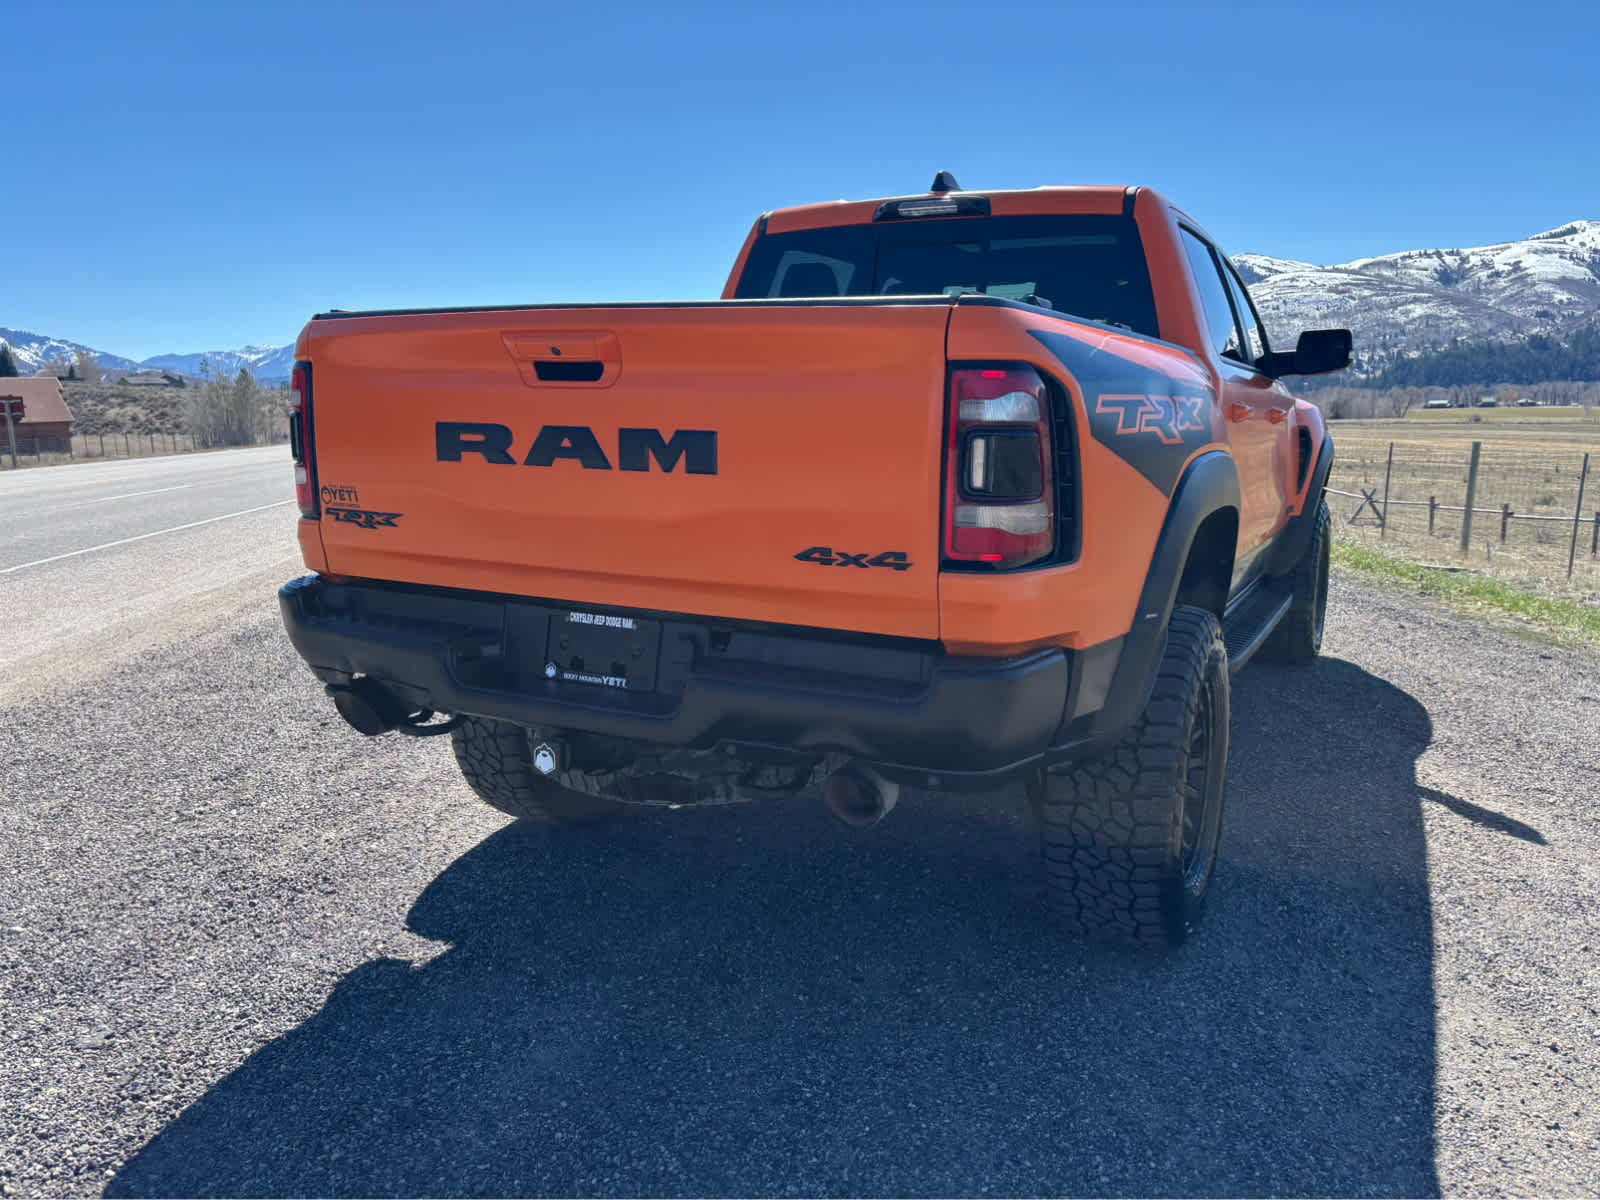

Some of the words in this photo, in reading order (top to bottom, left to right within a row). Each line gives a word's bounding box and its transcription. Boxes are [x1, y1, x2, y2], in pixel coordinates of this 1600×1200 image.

[1096, 394, 1205, 445] TRX
[435, 421, 718, 475] RAM
[331, 487, 359, 503] YETI
[325, 507, 404, 530] TRX
[793, 546, 915, 571] 4x4
[570, 611, 593, 624] CHRYSLER
[594, 615, 605, 626] JEEP
[605, 616, 622, 627] DODGE
[622, 617, 633, 629] RAM
[602, 676, 627, 688] YETI
